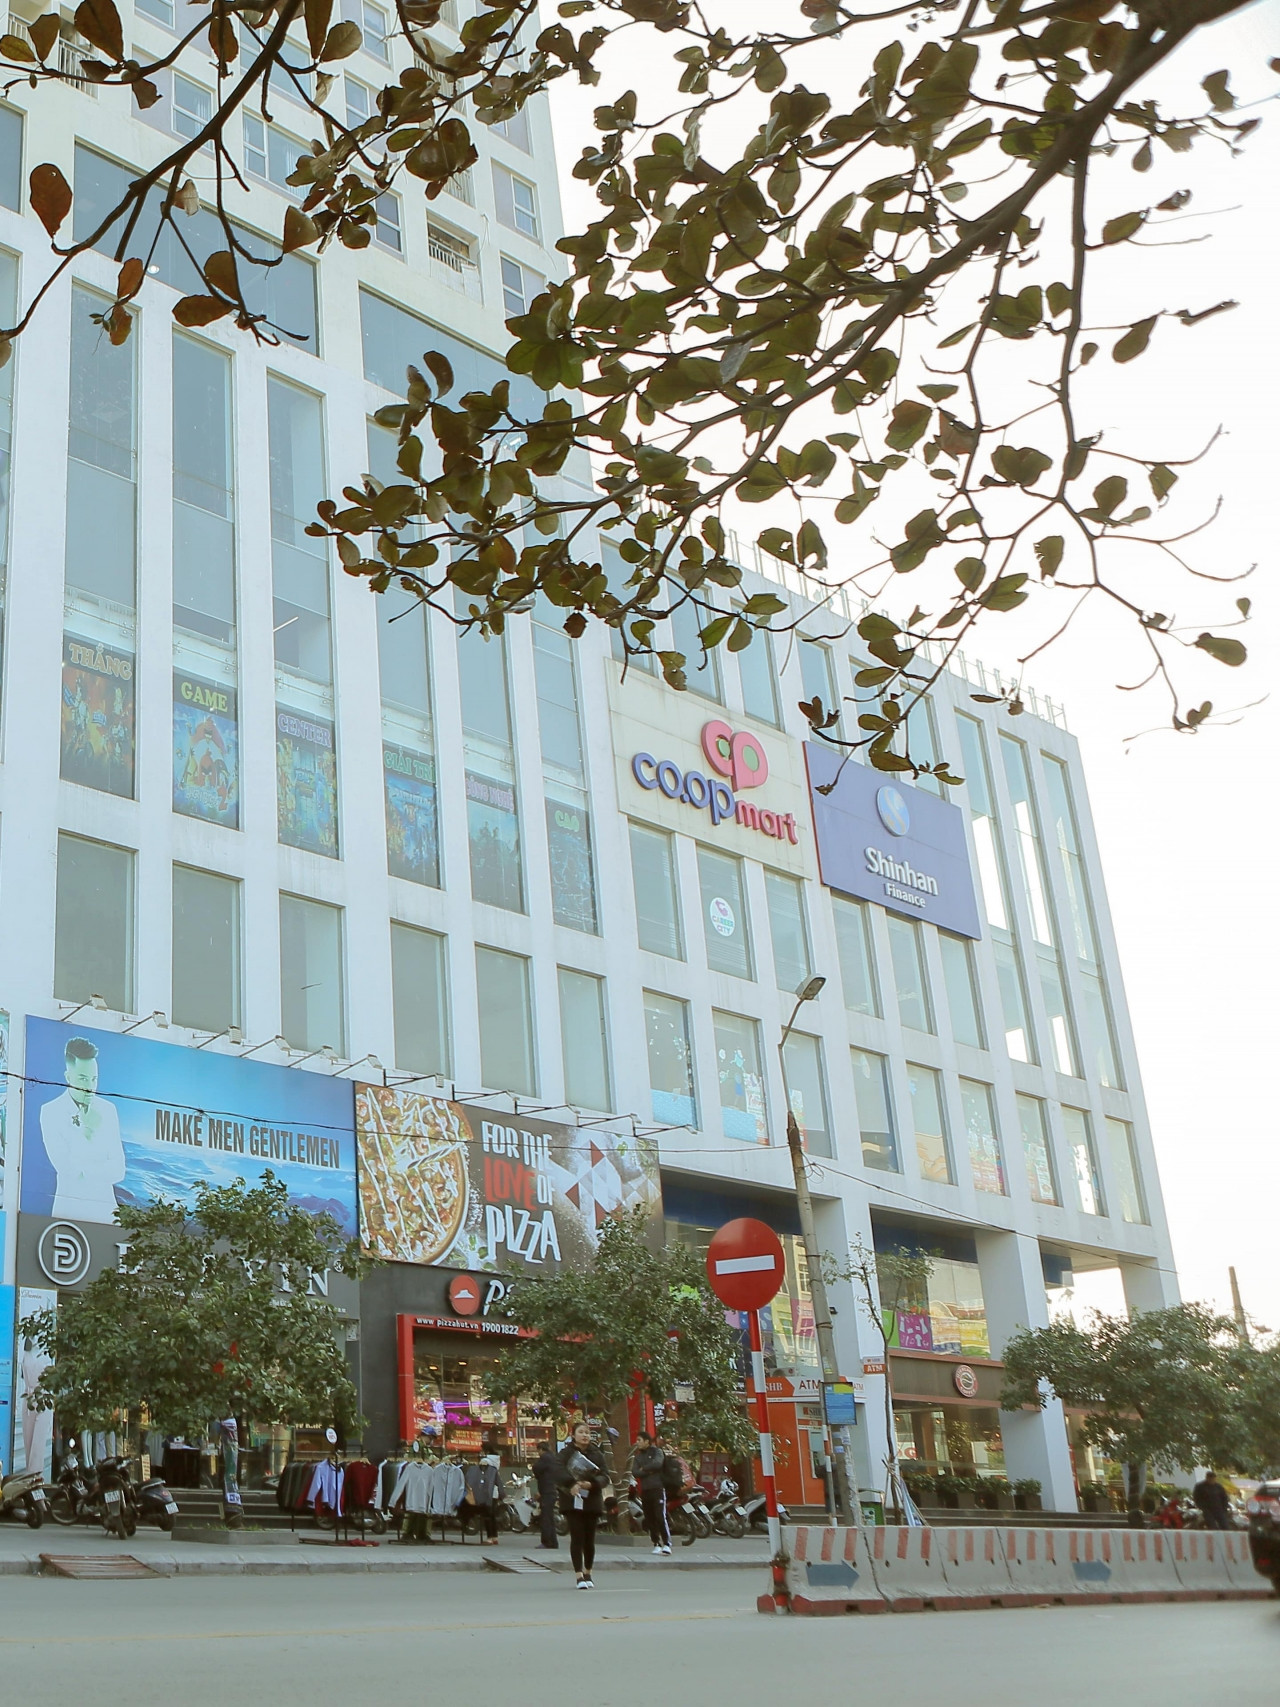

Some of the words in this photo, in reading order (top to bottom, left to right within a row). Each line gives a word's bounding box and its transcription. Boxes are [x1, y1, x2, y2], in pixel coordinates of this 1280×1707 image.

[181, 681, 228, 713] GAME
[278, 713, 332, 748] CENTER
[554, 810, 580, 832] CAO
[865, 846, 939, 896] Shinhan
[885, 882, 926, 909] Finance
[155, 1109, 203, 1147] MAKE
[208, 1118, 245, 1154] MEN
[249, 1123, 340, 1170] GENTLEMEN
[481, 1120, 521, 1159] FOR
[519, 1129, 553, 1171] THE
[484, 1156, 536, 1211] LOVE
[536, 1174, 555, 1206] OF
[485, 1204, 562, 1265] PIZZA
[800, 1380, 820, 1390] ATM
[867, 1363, 883, 1372] ATM
